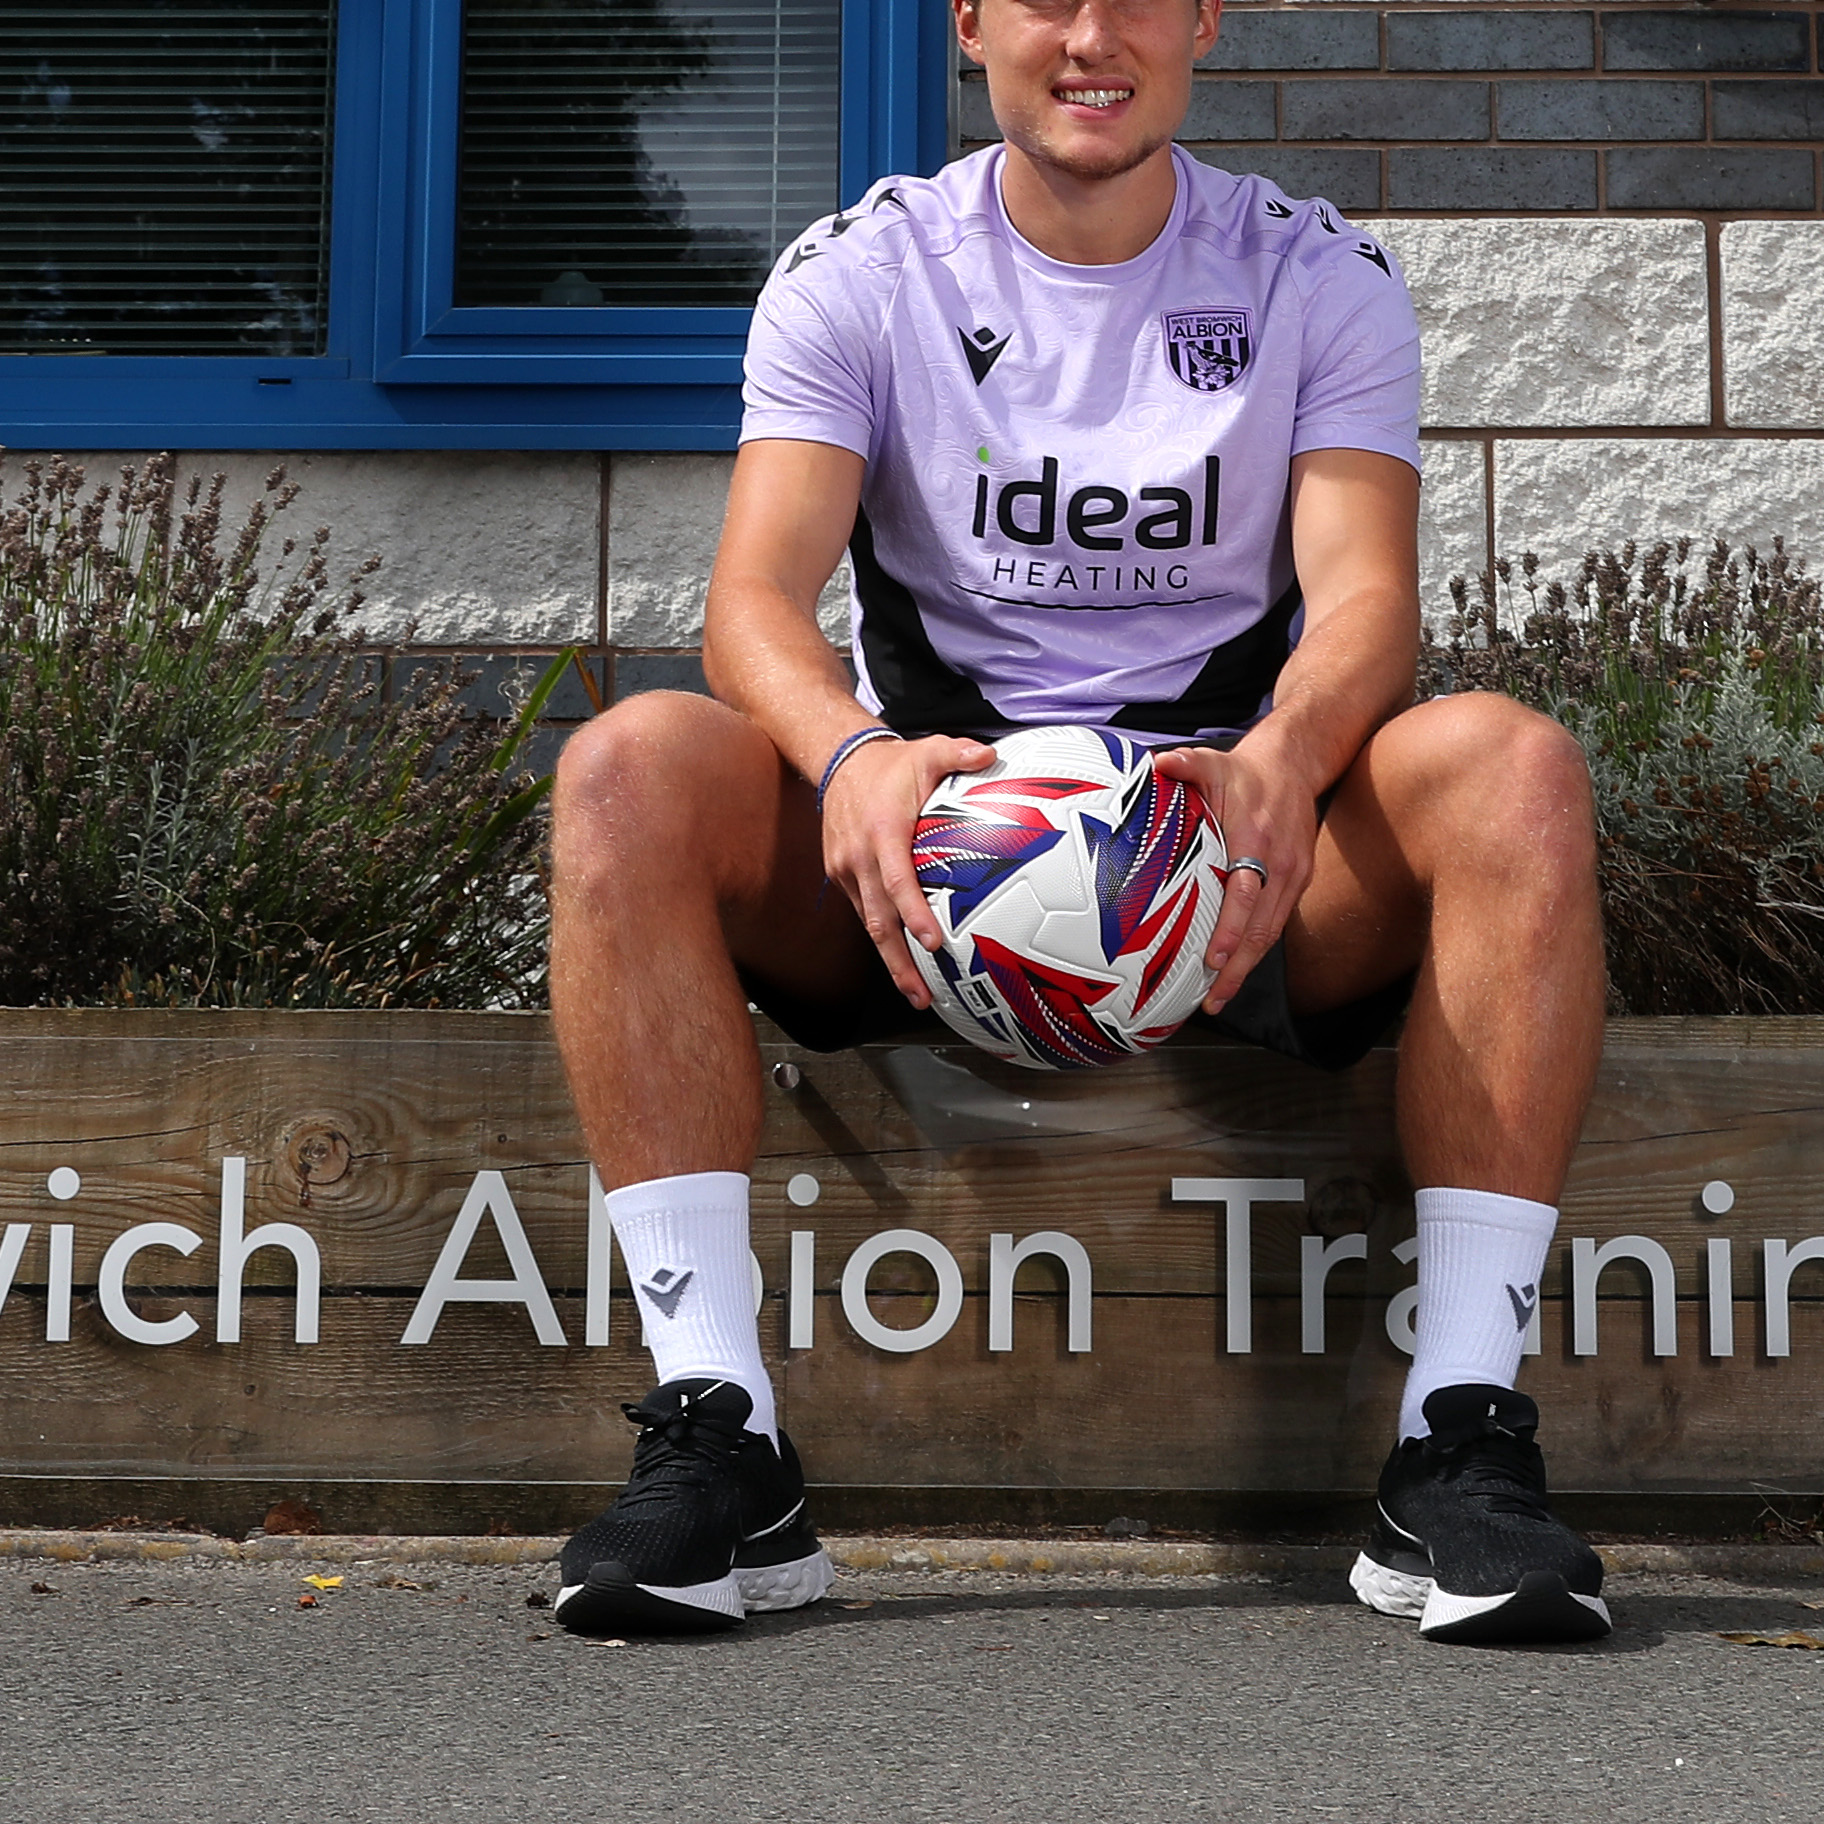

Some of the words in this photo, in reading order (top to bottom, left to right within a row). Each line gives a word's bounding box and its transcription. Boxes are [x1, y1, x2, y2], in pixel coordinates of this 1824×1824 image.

[1170, 317, 1194, 325] WEST
[1172, 321, 1244, 340] ALBION
[972, 446, 1221, 551] ideal
[992, 557, 1189, 591] HEATING
[399, 1159, 1093, 1354] Alion
